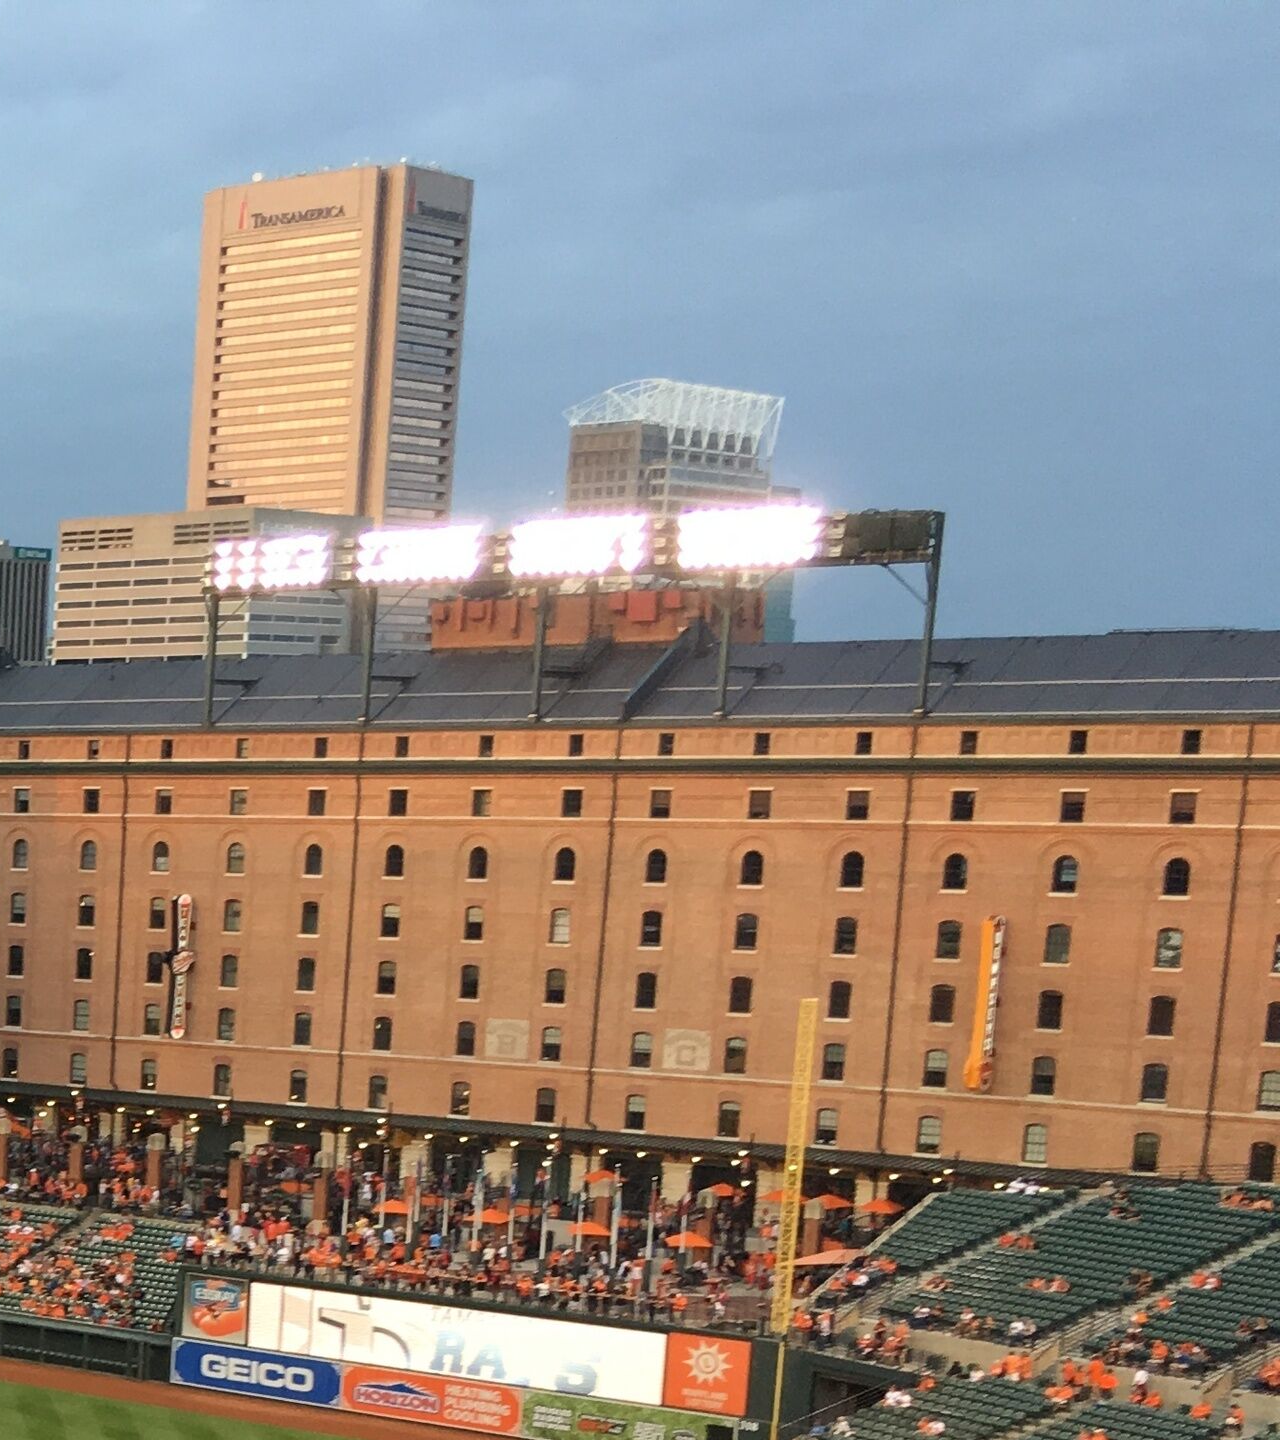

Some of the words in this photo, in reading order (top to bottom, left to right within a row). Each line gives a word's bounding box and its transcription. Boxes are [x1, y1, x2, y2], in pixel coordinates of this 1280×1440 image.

[251, 205, 346, 229] TRANSAMERICA
[199, 1353, 315, 1393] GEICO
[354, 1386, 438, 1413] HORIZON
[444, 1383, 502, 1402] HEATING
[442, 1408, 502, 1428] COOLING
[443, 1396, 511, 1418] PLUMBING
